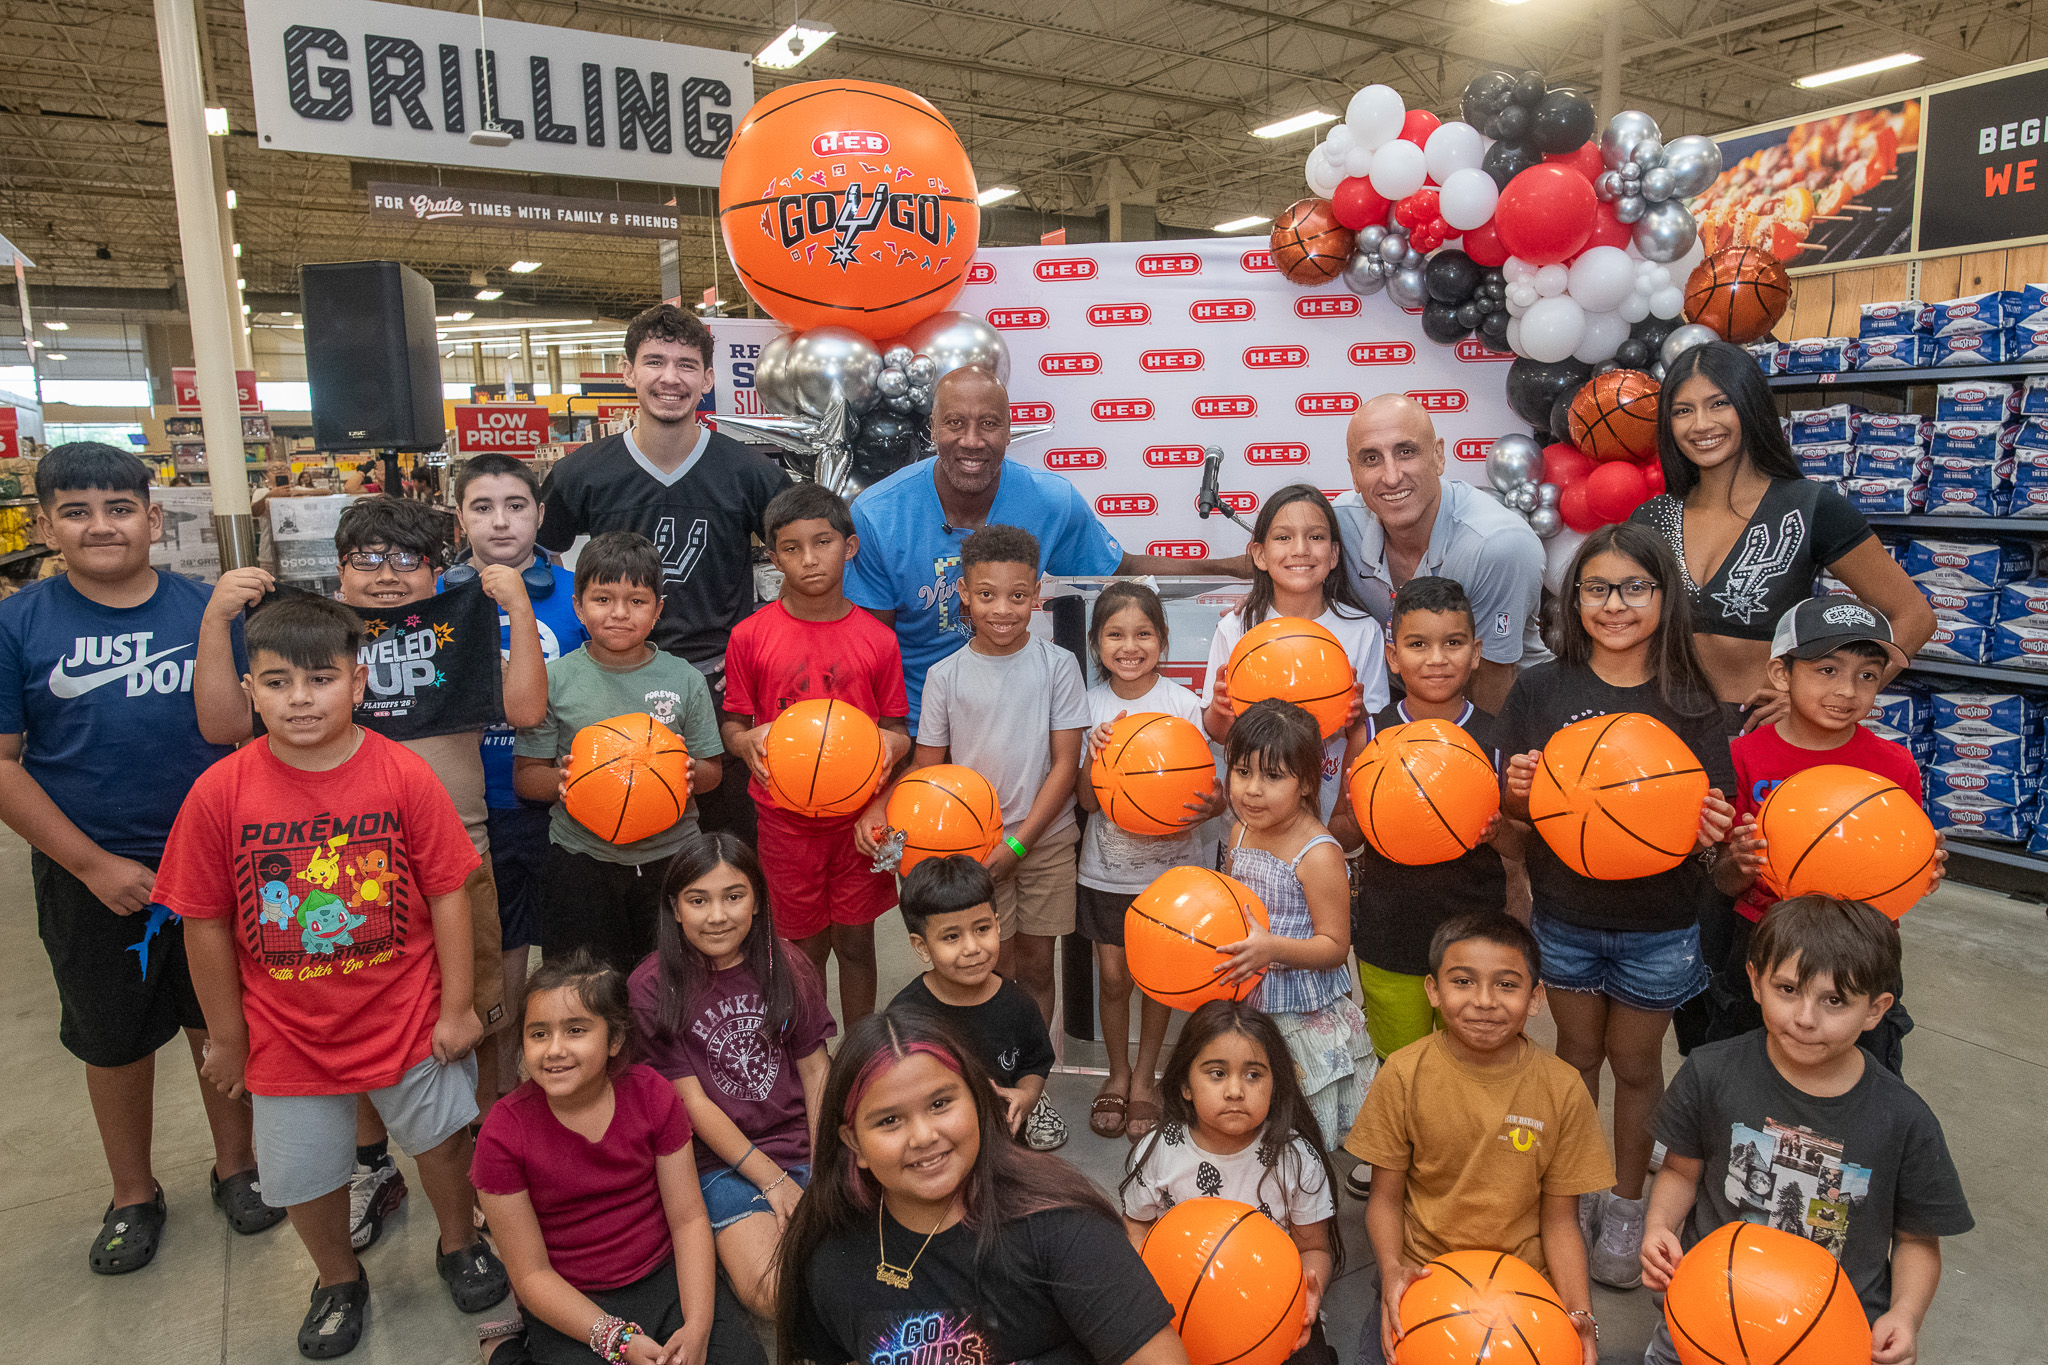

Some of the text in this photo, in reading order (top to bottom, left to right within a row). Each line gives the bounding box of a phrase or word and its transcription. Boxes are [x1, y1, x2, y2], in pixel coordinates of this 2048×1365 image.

[283, 25, 732, 159] GRILLING
[820, 136, 883, 152] H-E-B
[1985, 159, 2038, 198] WE
[375, 194, 678, 229] FOR Grate TIMES WITH FAMILY & FRIENDS
[778, 193, 941, 249] GO GO
[1041, 262, 1091, 277] H-E-B
[1144, 258, 1194, 272] H-E-B
[1197, 304, 1248, 318] H-E-B
[1302, 300, 1354, 314] H-E-B
[1948, 305, 1977, 317] KINGSFORD
[993, 313, 1042, 326] H-E-B
[1094, 308, 1144, 321] H-E-B
[1868, 344, 1895, 354] KINGSFORD
[1950, 340, 1980, 350] KINGSFORD
[1250, 350, 1301, 363] H-E-B
[1356, 346, 1407, 360] H-E-B
[1046, 358, 1095, 371] H-E-B
[1147, 353, 1197, 367] H-E-B
[1819, 373, 1836, 383] A8
[1957, 391, 1985, 401] KINGSFORD
[1098, 404, 1148, 417] H-E-B
[1200, 401, 1250, 414] H-E-B
[1303, 398, 1354, 411] H-E-B
[1010, 407, 1047, 420] -E-B
[477, 413, 527, 429] LOW
[466, 430, 541, 446] PRICES
[1949, 428, 1976, 438] KINGSFORD
[1051, 452, 1099, 465] H-E-B
[1150, 450, 1199, 463] H-E-B
[1252, 448, 1302, 461] H-E-B
[1944, 490, 1974, 501] KINGSFORD
[2029, 491, 2048, 503] KINGS
[1102, 498, 1151, 511] H-E-B
[1153, 544, 1202, 558] H-E-B
[1934, 554, 1967, 566] KINGSFORD
[918, 576, 961, 611] Viv
[1932, 595, 1965, 607] KINGSFORD
[1931, 629, 1952, 640] SFORD
[66, 631, 153, 667] JUST
[2022, 641, 2048, 652] KINGSFO
[367, 659, 436, 696] UP
[644, 690, 681, 704] FOREVER
[363, 701, 399, 709] PLAYOFFS
[1917, 710, 1929, 720] THE
[1957, 706, 1989, 718] KINGSFORD
[483, 736, 515, 746] NTUR
[1916, 743, 1930, 753] THE
[1956, 745, 1989, 758] KINGSFORD
[1948, 775, 1985, 788] KINGSFORD
[2023, 778, 2038, 789] THE
[1951, 811, 1983, 823] KINGSFORD
[240, 811, 402, 848] POKÉMON
[264, 937, 394, 967] FIRST PARTNERS
[298, 963, 333, 982] Catch
[340, 958, 364, 975] 'Em
[368, 948, 394, 968] All!
[720, 1024, 733, 1038] OF
[900, 1314, 944, 1349] GO
